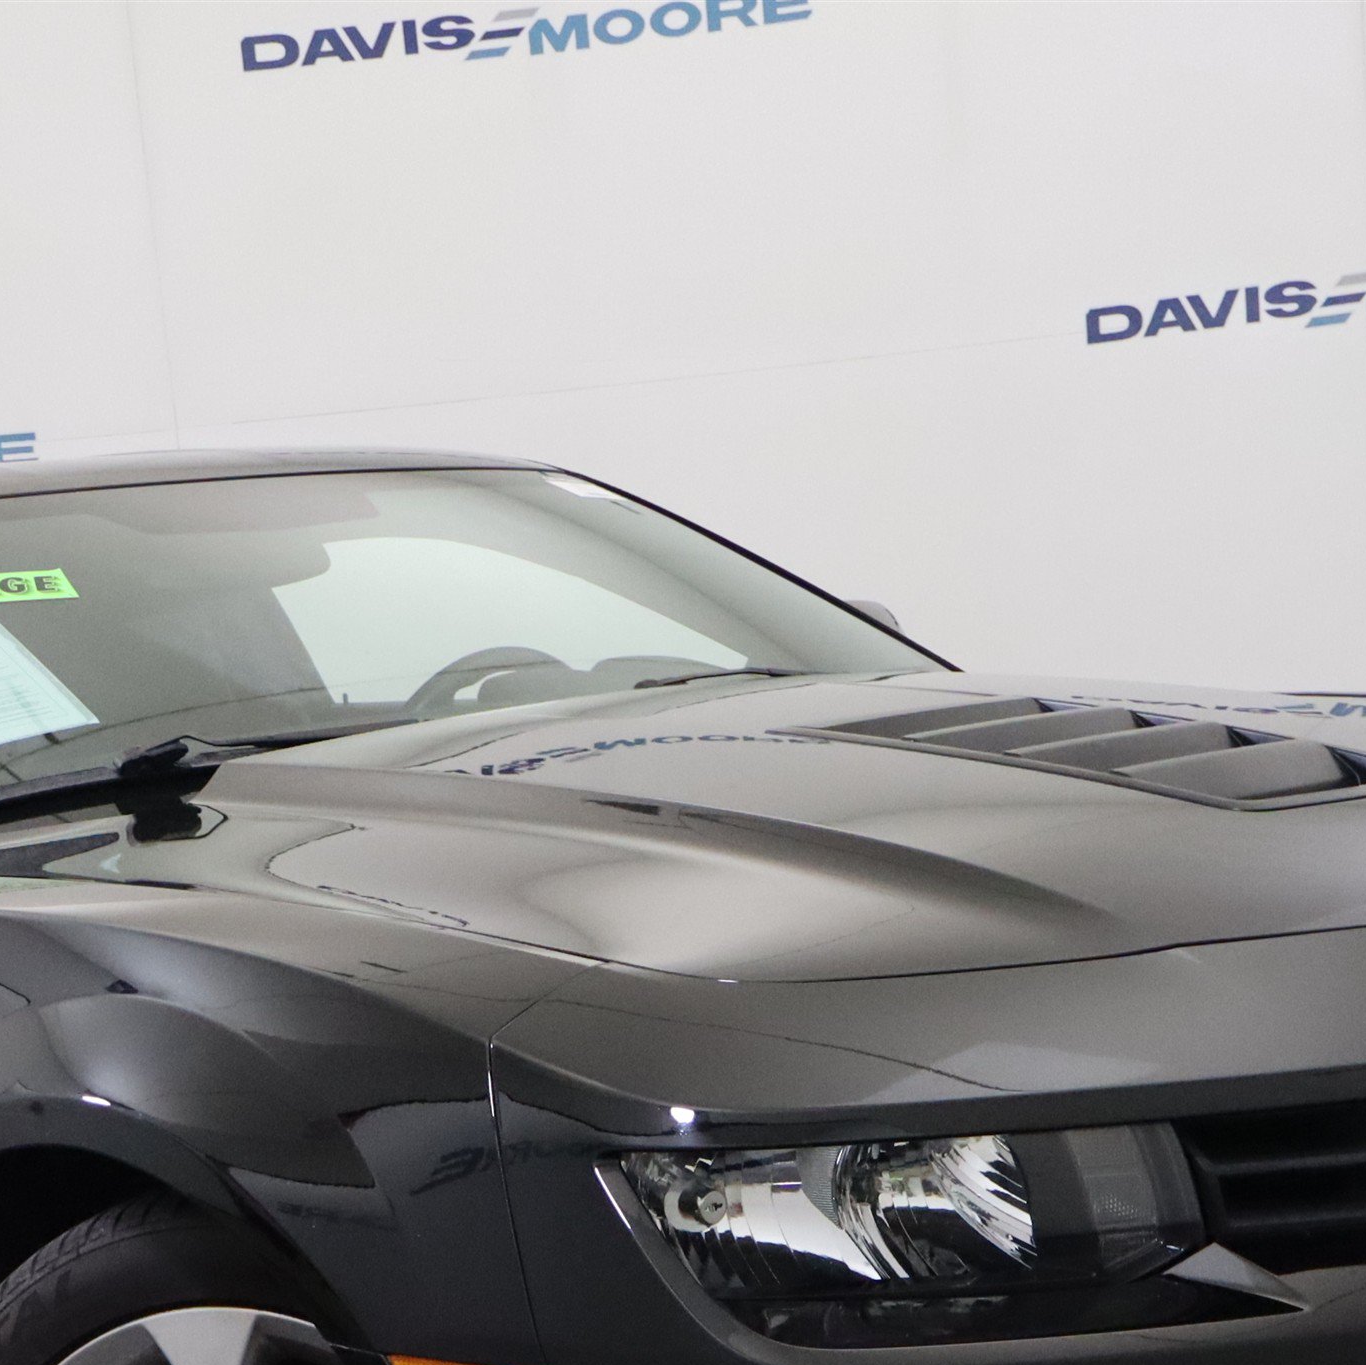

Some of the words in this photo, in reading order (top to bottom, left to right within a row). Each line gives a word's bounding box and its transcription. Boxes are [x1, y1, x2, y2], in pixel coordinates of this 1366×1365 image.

[241, 15, 476, 72] DAVIS
[527, 0, 813, 56] MOORE
[1085, 280, 1318, 345] DAVIS
